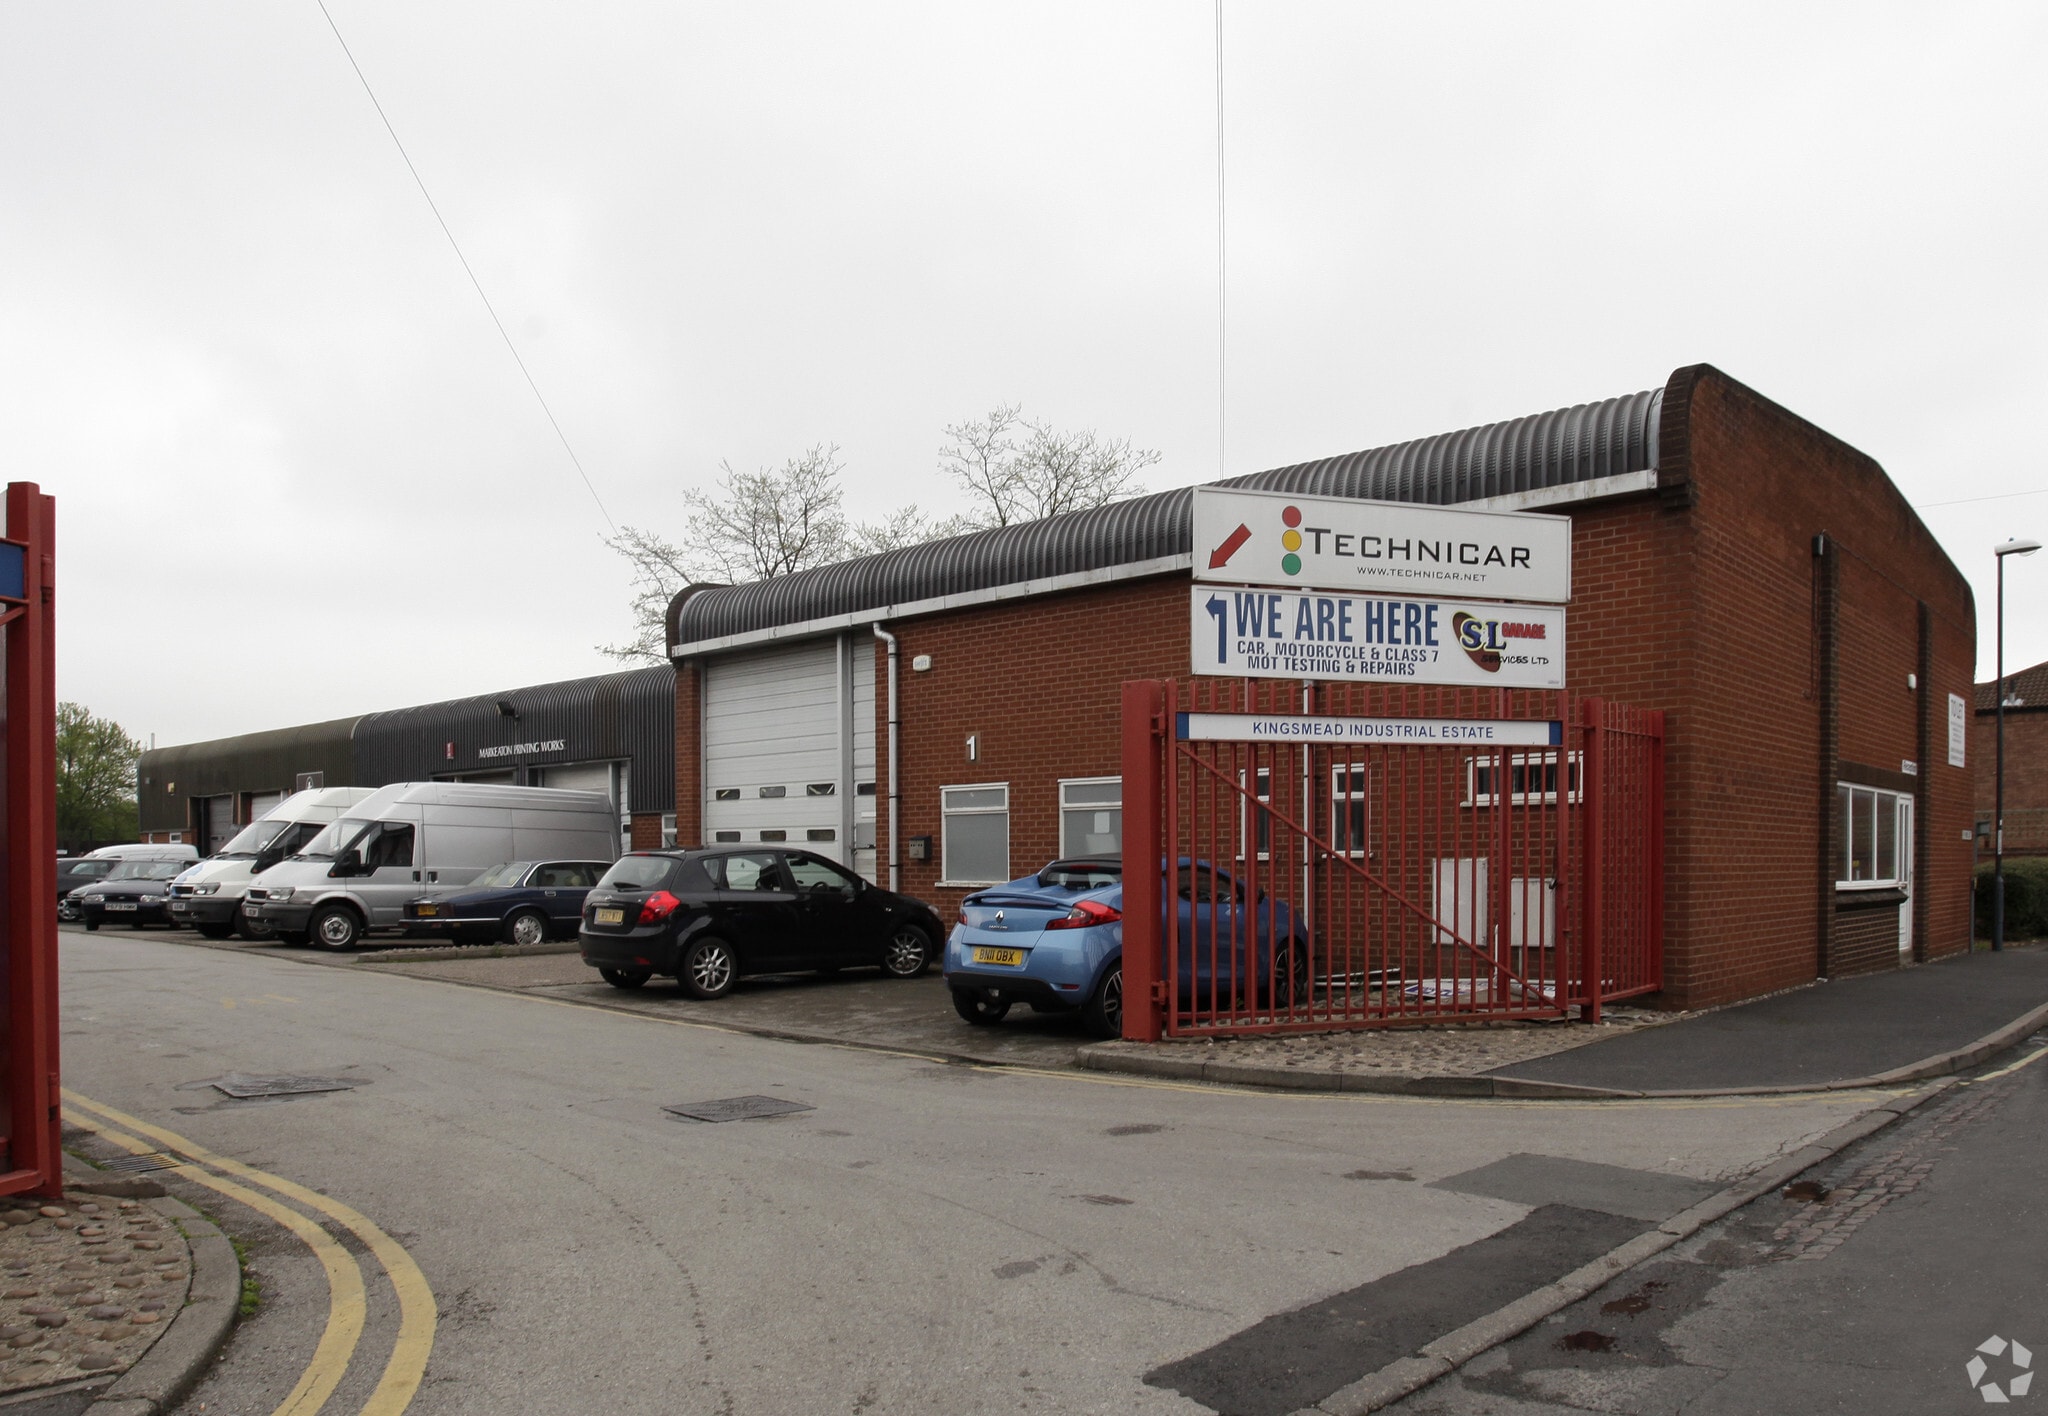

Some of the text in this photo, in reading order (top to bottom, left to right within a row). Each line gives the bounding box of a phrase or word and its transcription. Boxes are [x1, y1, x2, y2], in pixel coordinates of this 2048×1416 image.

[1305, 527, 1531, 569] TECHNICAR
[1357, 566, 1487, 583] WWW.TECHNICAR.NET
[1234, 592, 1439, 647] WE ARE HERE
[1501, 621, 1546, 640] GARAGE
[1237, 640, 1439, 663] CAR, MOTORCYCLE & CLASS 7
[1531, 656, 1549, 665] LTD
[1248, 655, 1415, 676] MOT TESTING & REPAIRS
[1252, 721, 1494, 739] KINGSMEAD INDUSTRIAL ESTATE
[479, 739, 565, 759] MARKEATON PRINTING WORKS
[966, 735, 976, 761] 1
[996, 950, 1015, 963] OBX
